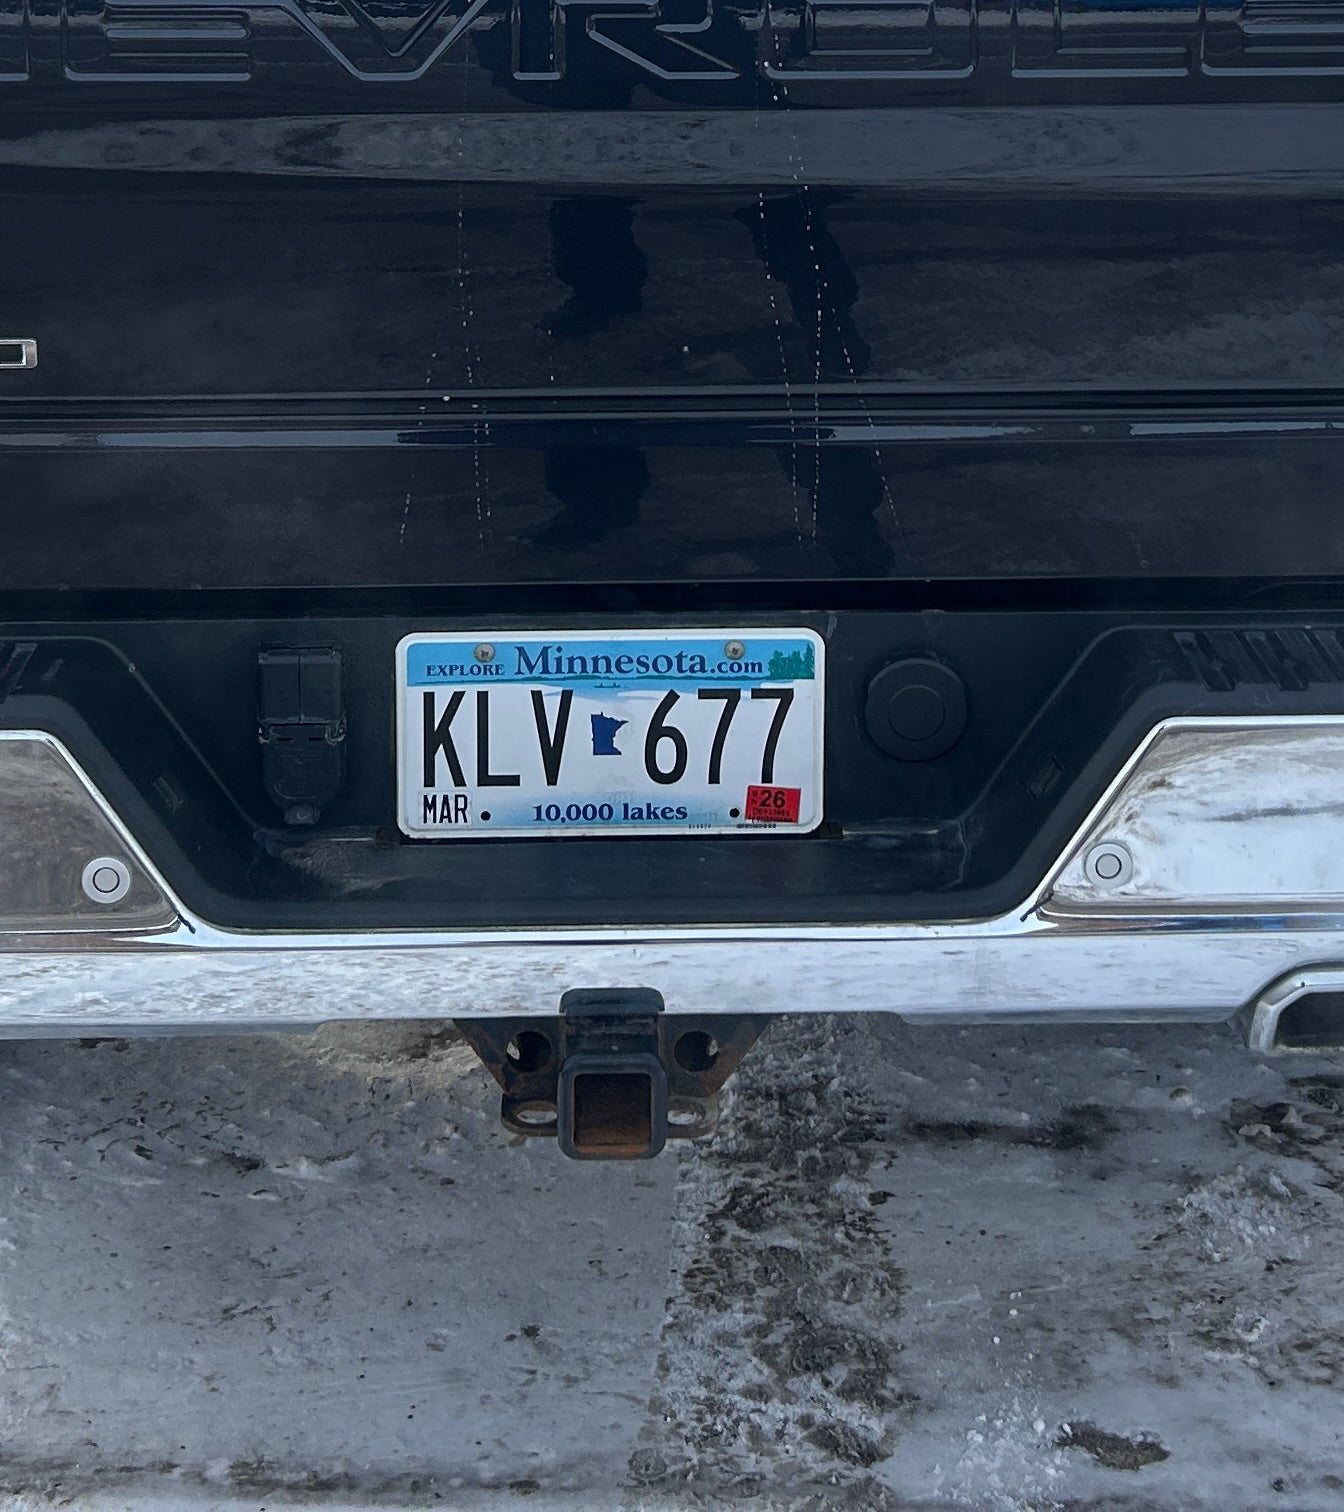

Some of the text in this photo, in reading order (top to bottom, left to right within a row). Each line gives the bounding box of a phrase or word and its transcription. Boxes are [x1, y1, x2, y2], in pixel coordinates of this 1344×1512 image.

[426, 644, 764, 677] EXPLORE Minnesota.com
[422, 688, 795, 788] KLV 677
[423, 793, 469, 825] MAR
[533, 801, 689, 824] 10,000 lakes
[758, 789, 786, 809] 26
